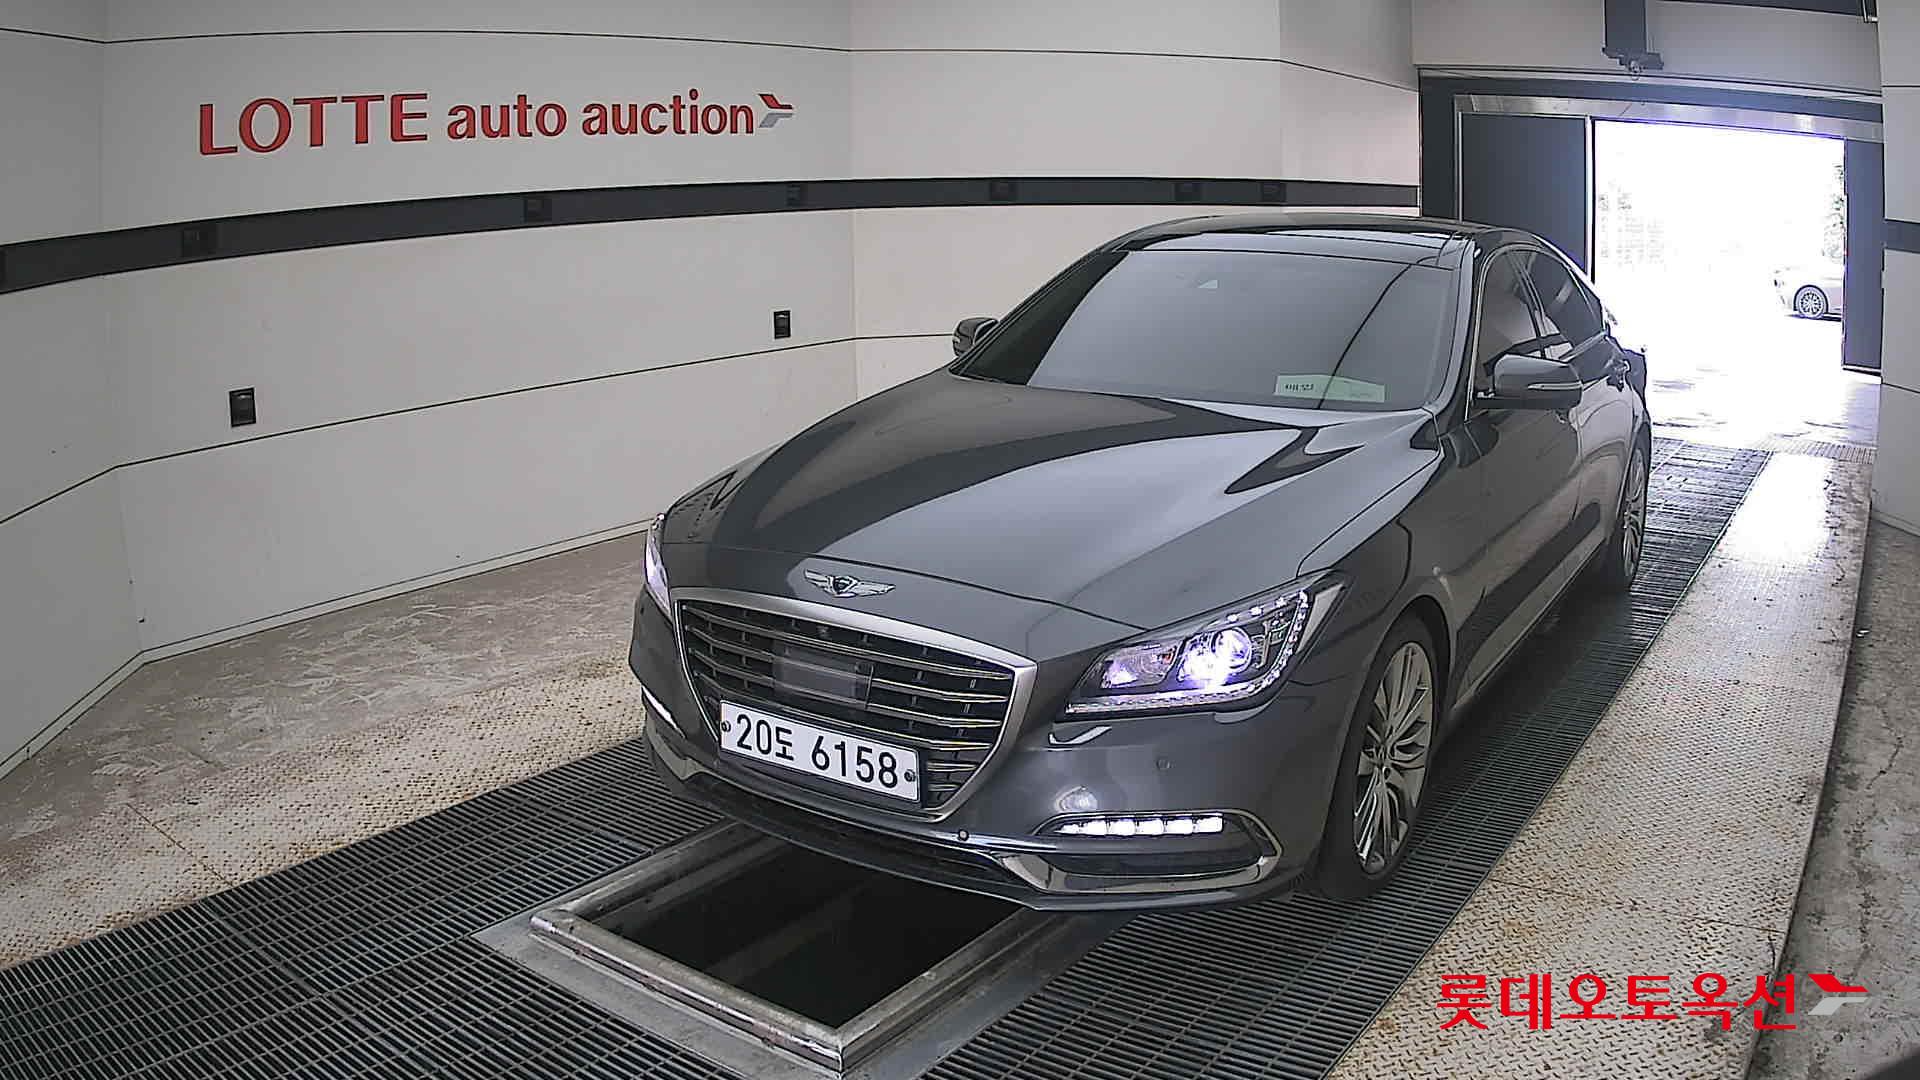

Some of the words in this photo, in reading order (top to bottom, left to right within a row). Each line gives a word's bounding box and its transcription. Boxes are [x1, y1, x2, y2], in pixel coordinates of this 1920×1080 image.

[200, 92, 428, 156] LOTTE
[446, 93, 568, 140] auto
[582, 88, 755, 136] auction
[736, 713, 794, 761] 20도
[811, 735, 898, 788] 6158
